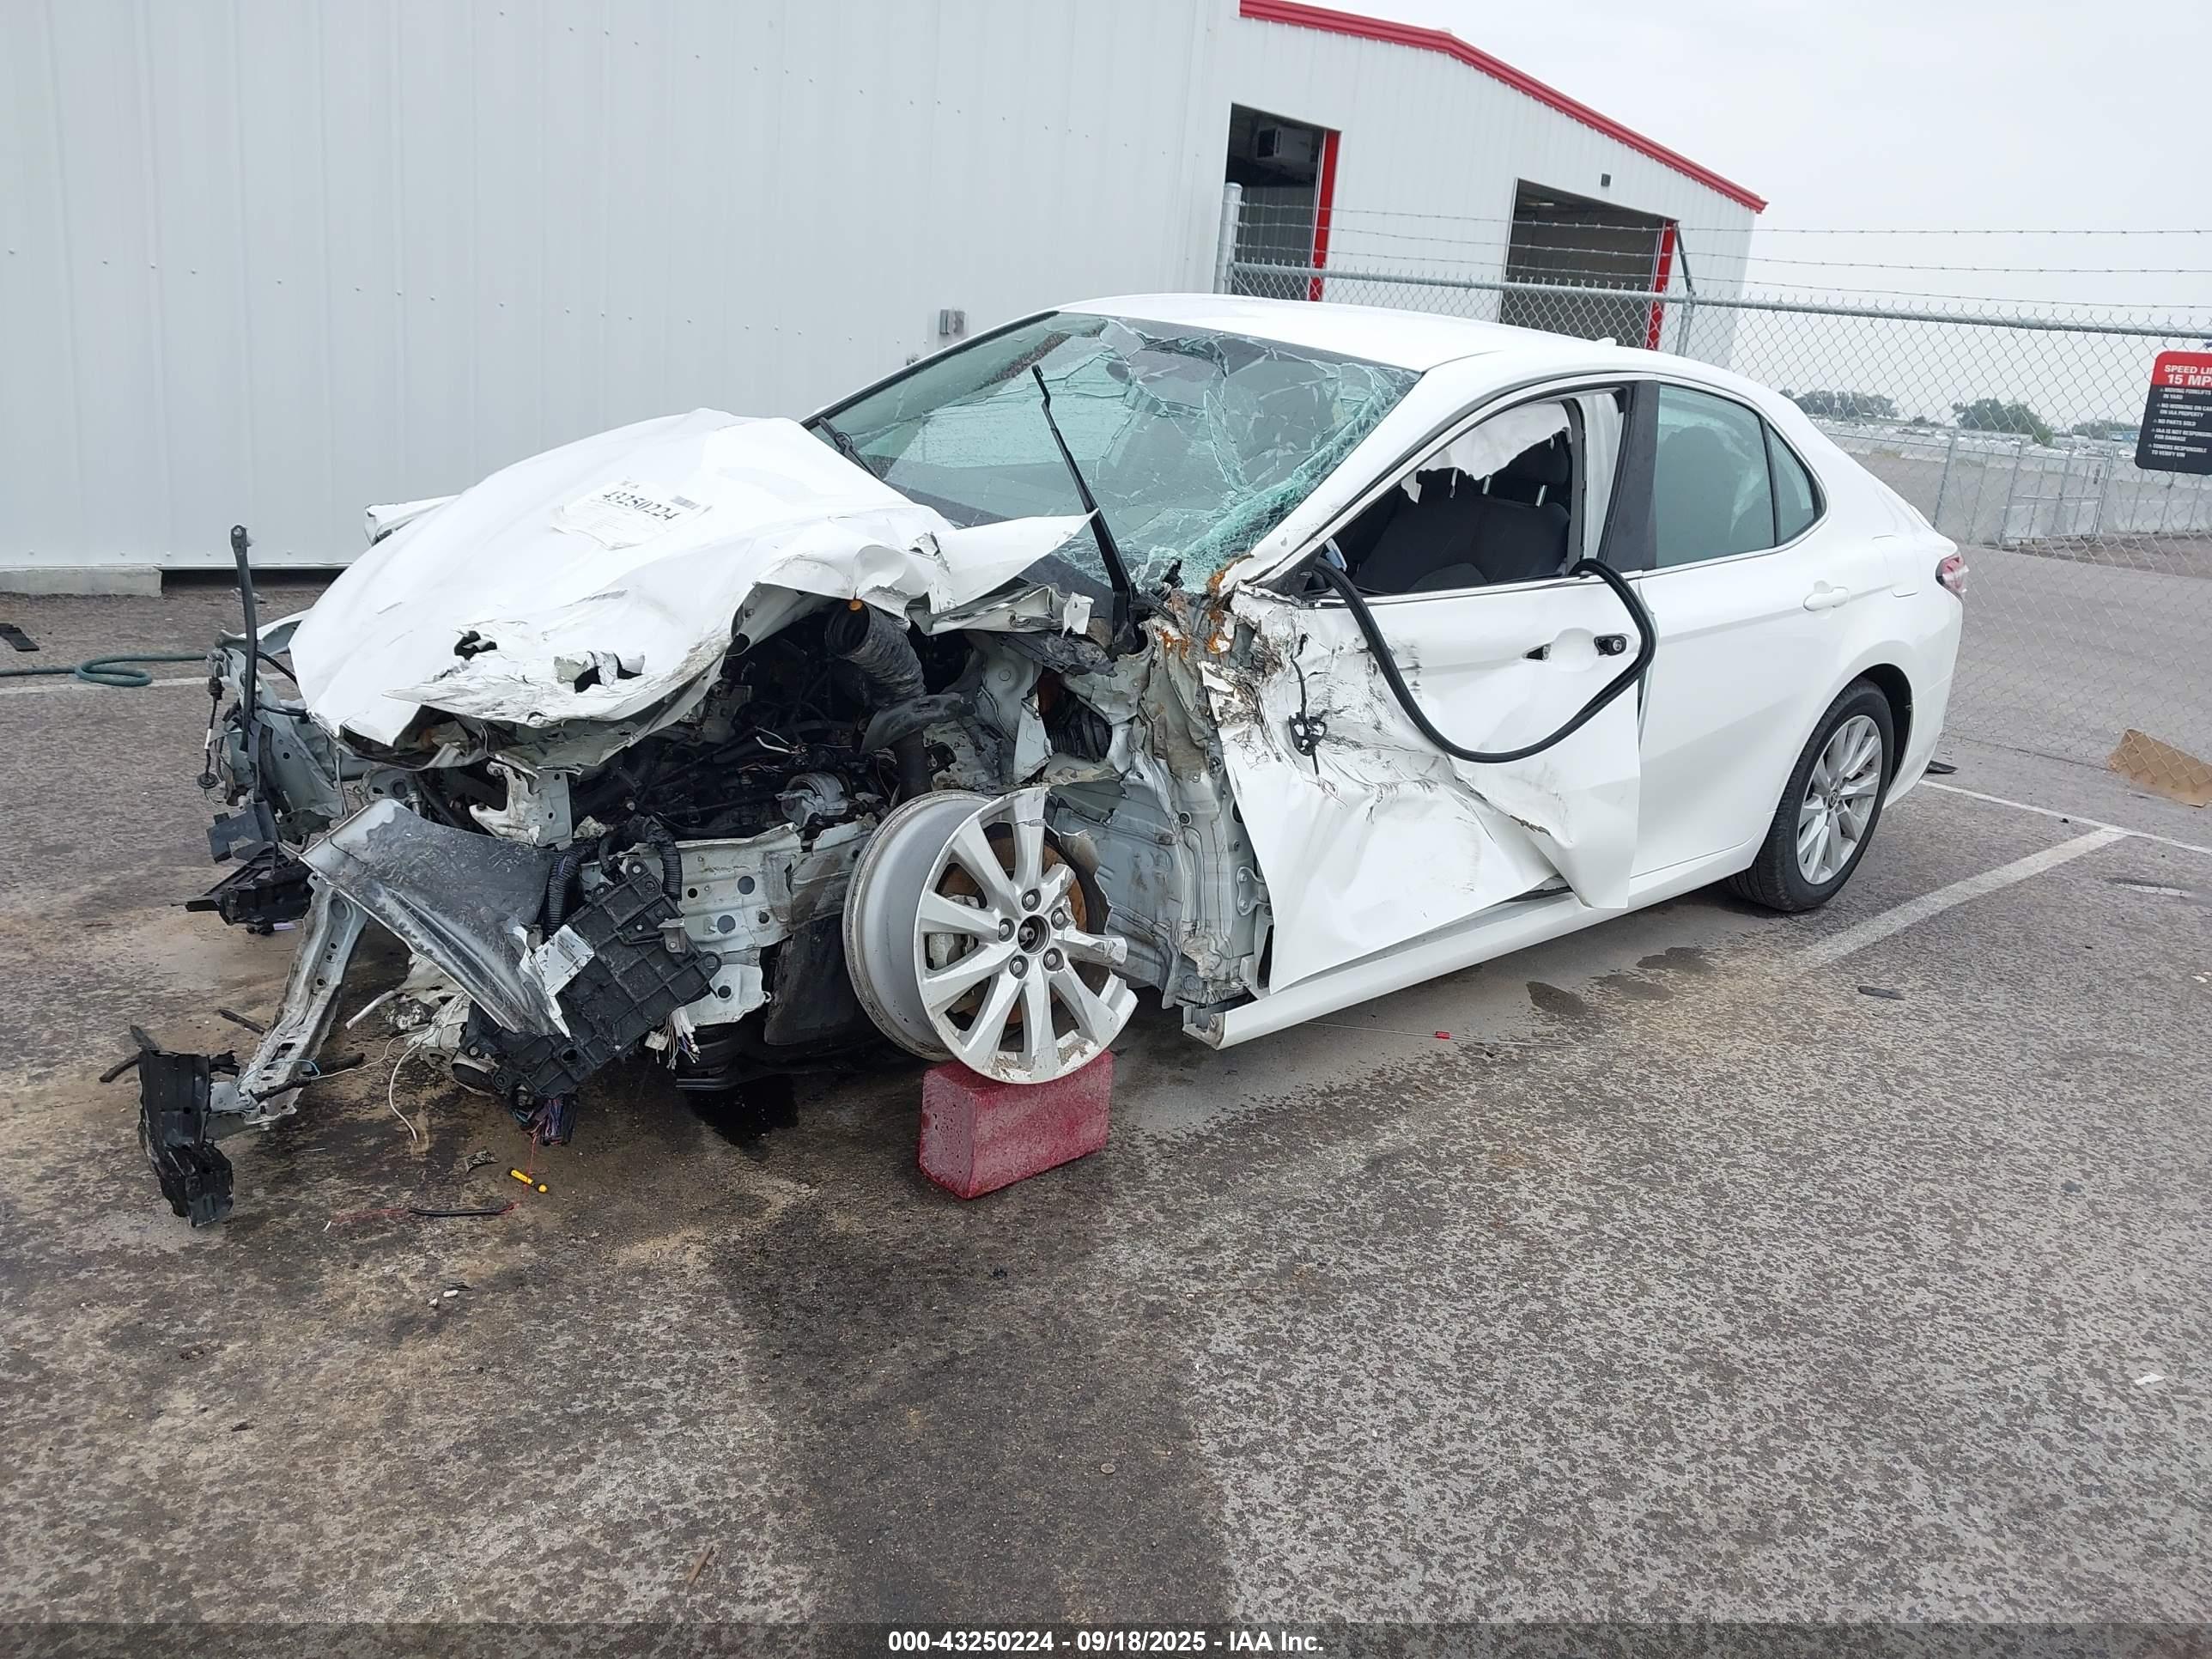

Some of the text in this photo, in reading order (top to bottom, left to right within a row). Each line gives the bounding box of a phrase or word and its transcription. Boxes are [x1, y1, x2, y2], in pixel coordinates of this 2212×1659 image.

[2164, 364, 2198, 374] SPEED
[2167, 374, 2212, 386] 15 MP
[602, 490, 680, 521] 43250224
